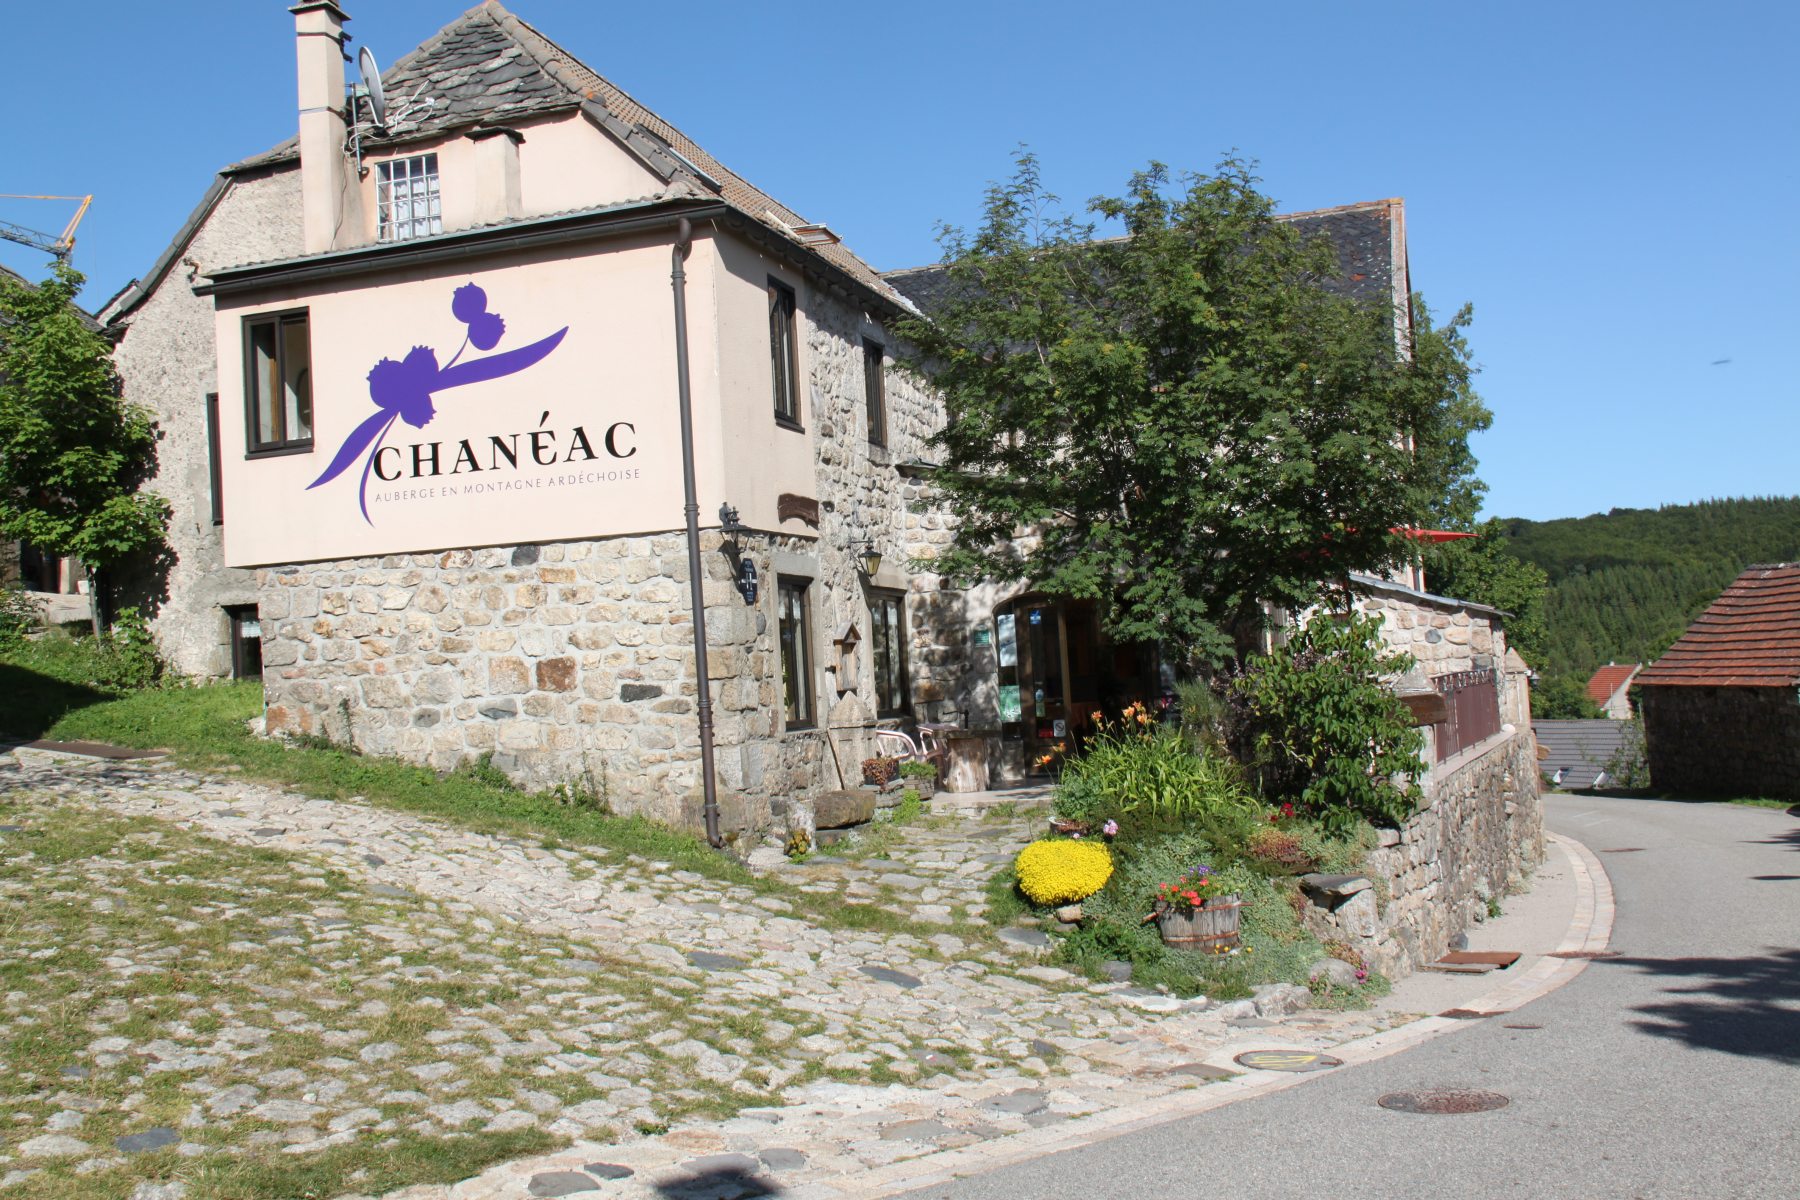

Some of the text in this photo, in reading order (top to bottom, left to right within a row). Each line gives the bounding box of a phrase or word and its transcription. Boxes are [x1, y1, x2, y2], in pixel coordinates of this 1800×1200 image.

[373, 410, 637, 482] CHANÉAC
[375, 468, 640, 503] AUBERGE EN MONTAGNE ARDÉCHOISE
